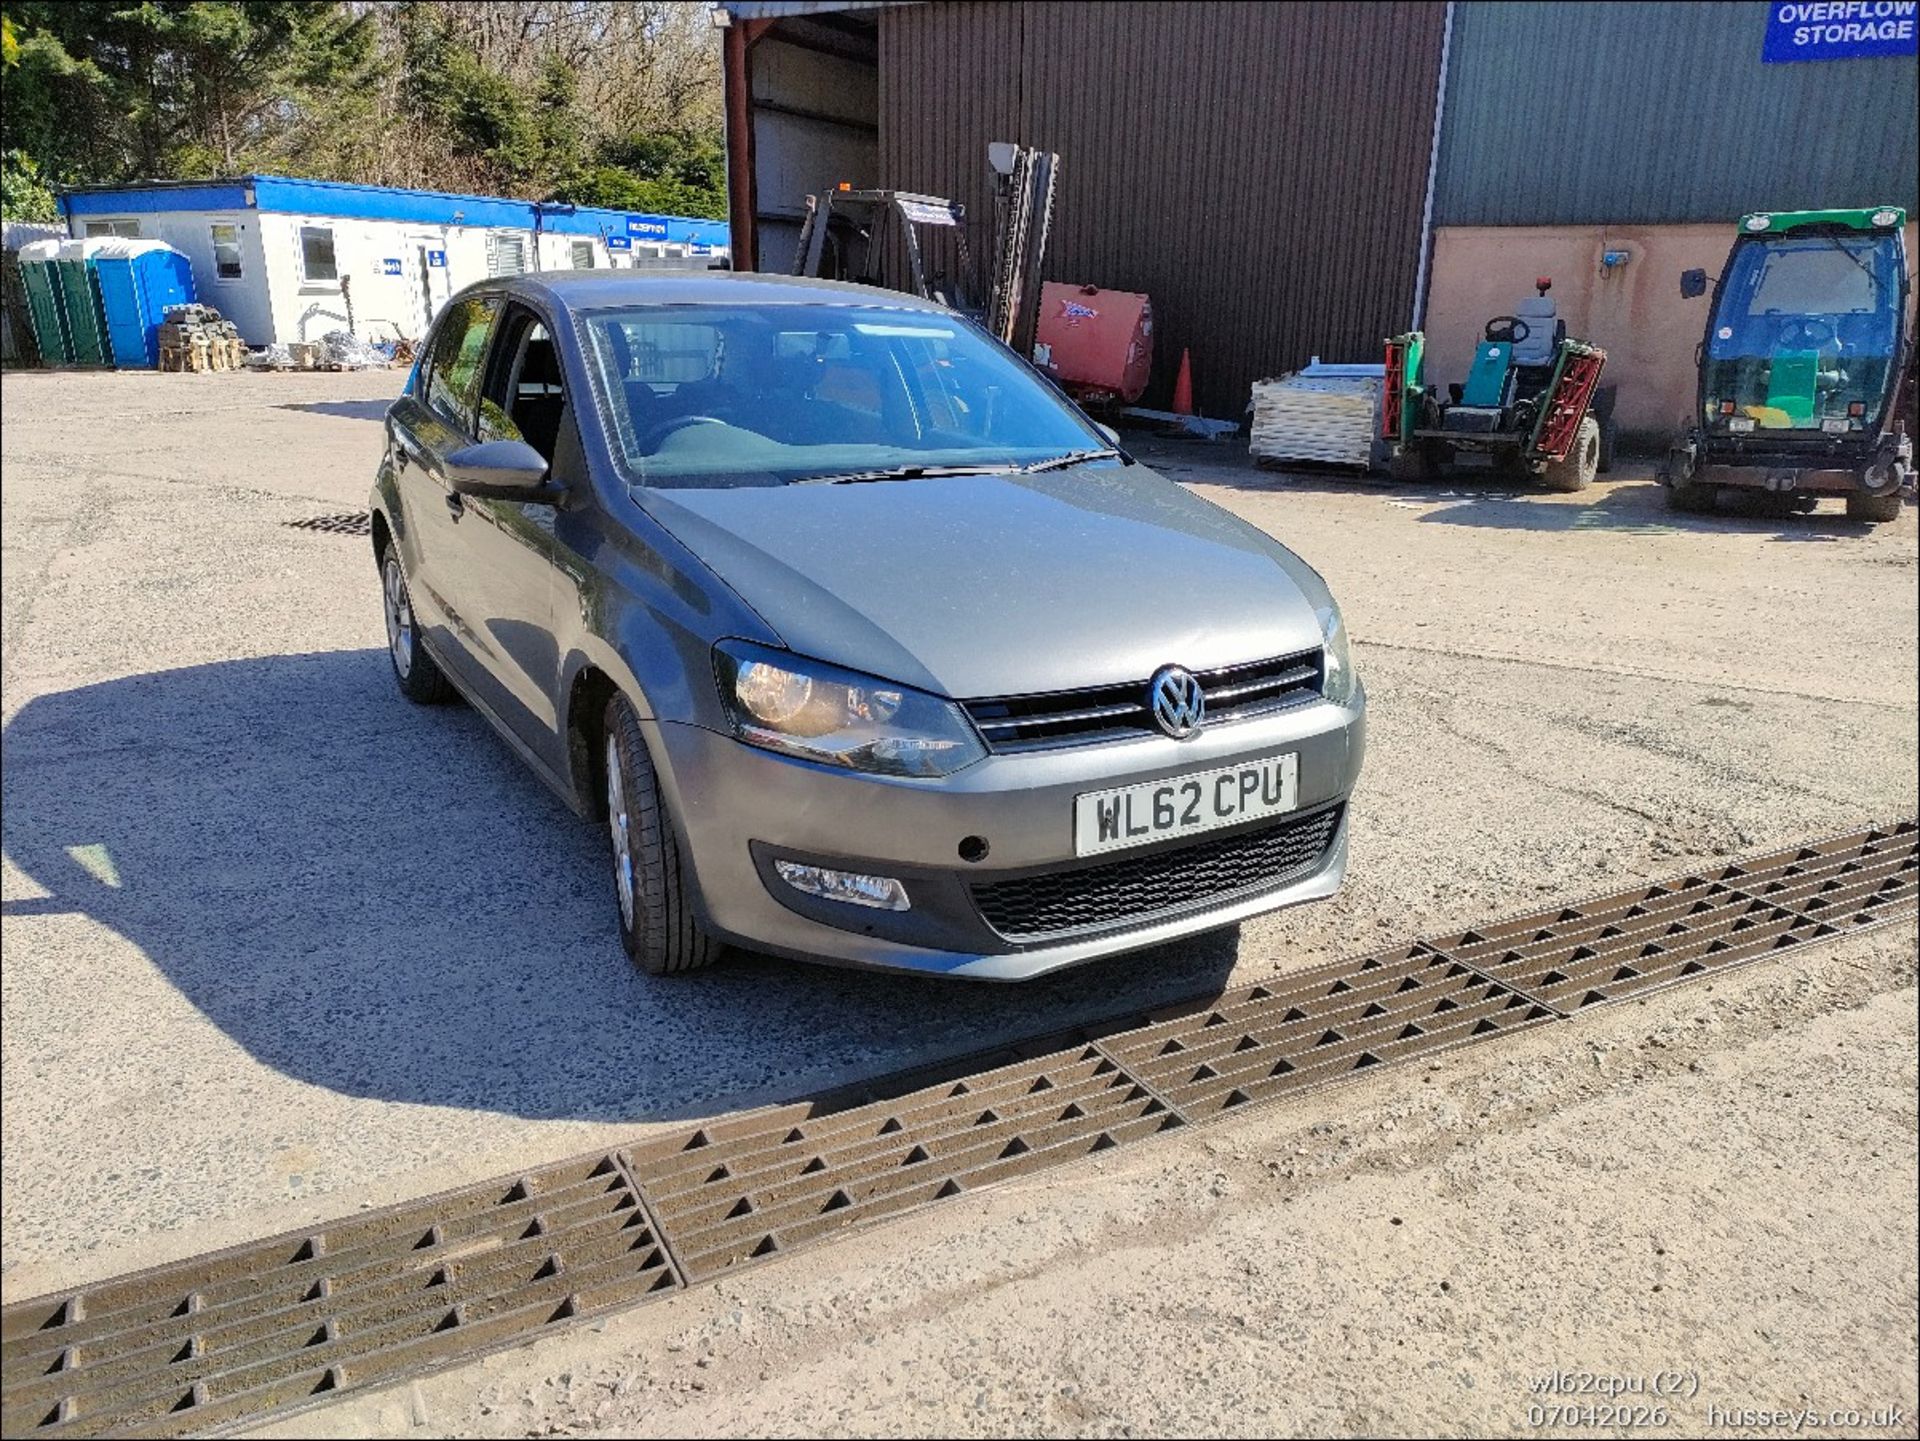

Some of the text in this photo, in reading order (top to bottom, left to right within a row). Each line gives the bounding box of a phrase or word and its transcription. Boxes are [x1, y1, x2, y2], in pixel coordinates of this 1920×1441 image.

[1778, 1, 1916, 24] OVERFLOW
[1793, 20, 1914, 46] STORAGE
[1097, 763, 1283, 843] WL62 CPU
